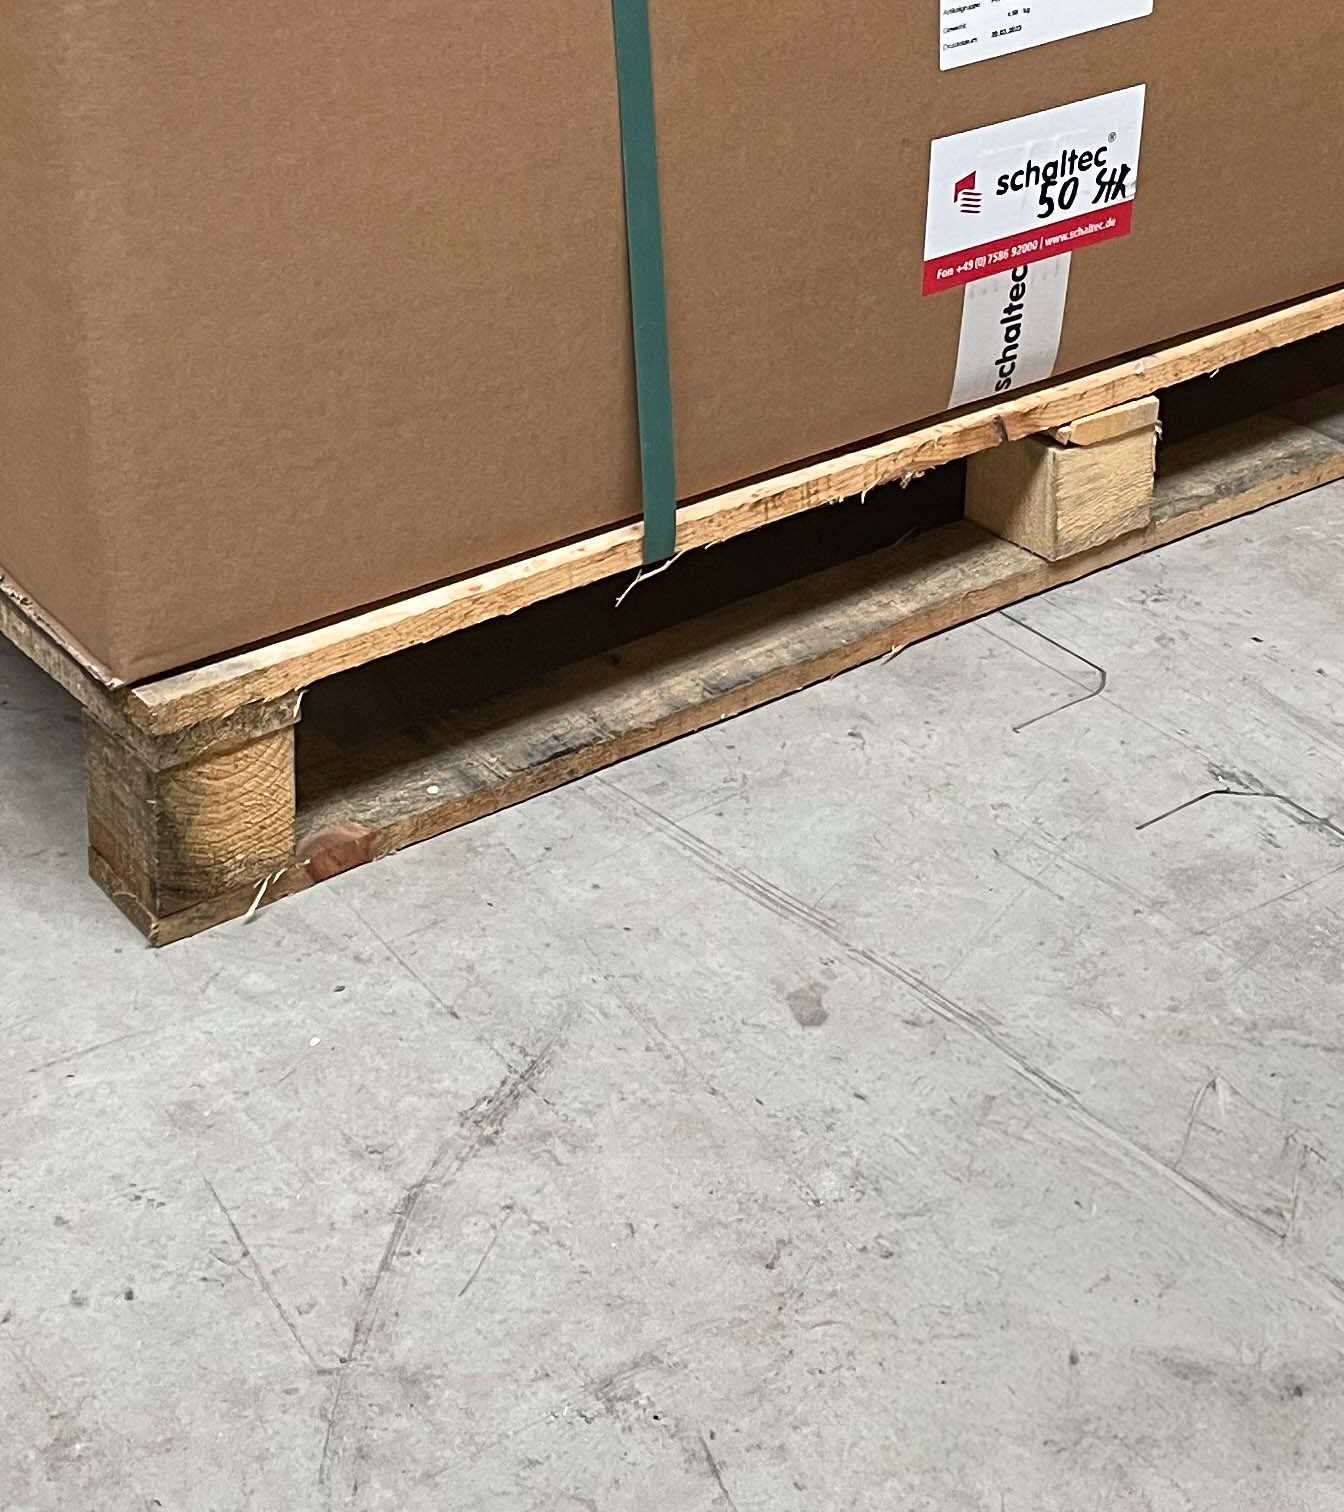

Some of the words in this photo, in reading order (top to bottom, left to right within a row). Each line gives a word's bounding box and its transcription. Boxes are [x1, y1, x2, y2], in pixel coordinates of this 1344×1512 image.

[995, 146, 1108, 195] schaltec
[1037, 177, 1079, 219] 50
[936, 267, 954, 280] Fon
[956, 259, 974, 274] +49
[974, 255, 986, 269] (0)
[1010, 240, 1038, 258] 92000
[1044, 218, 1117, 246] www.schaltec.de
[995, 264, 1027, 392] schaltec
